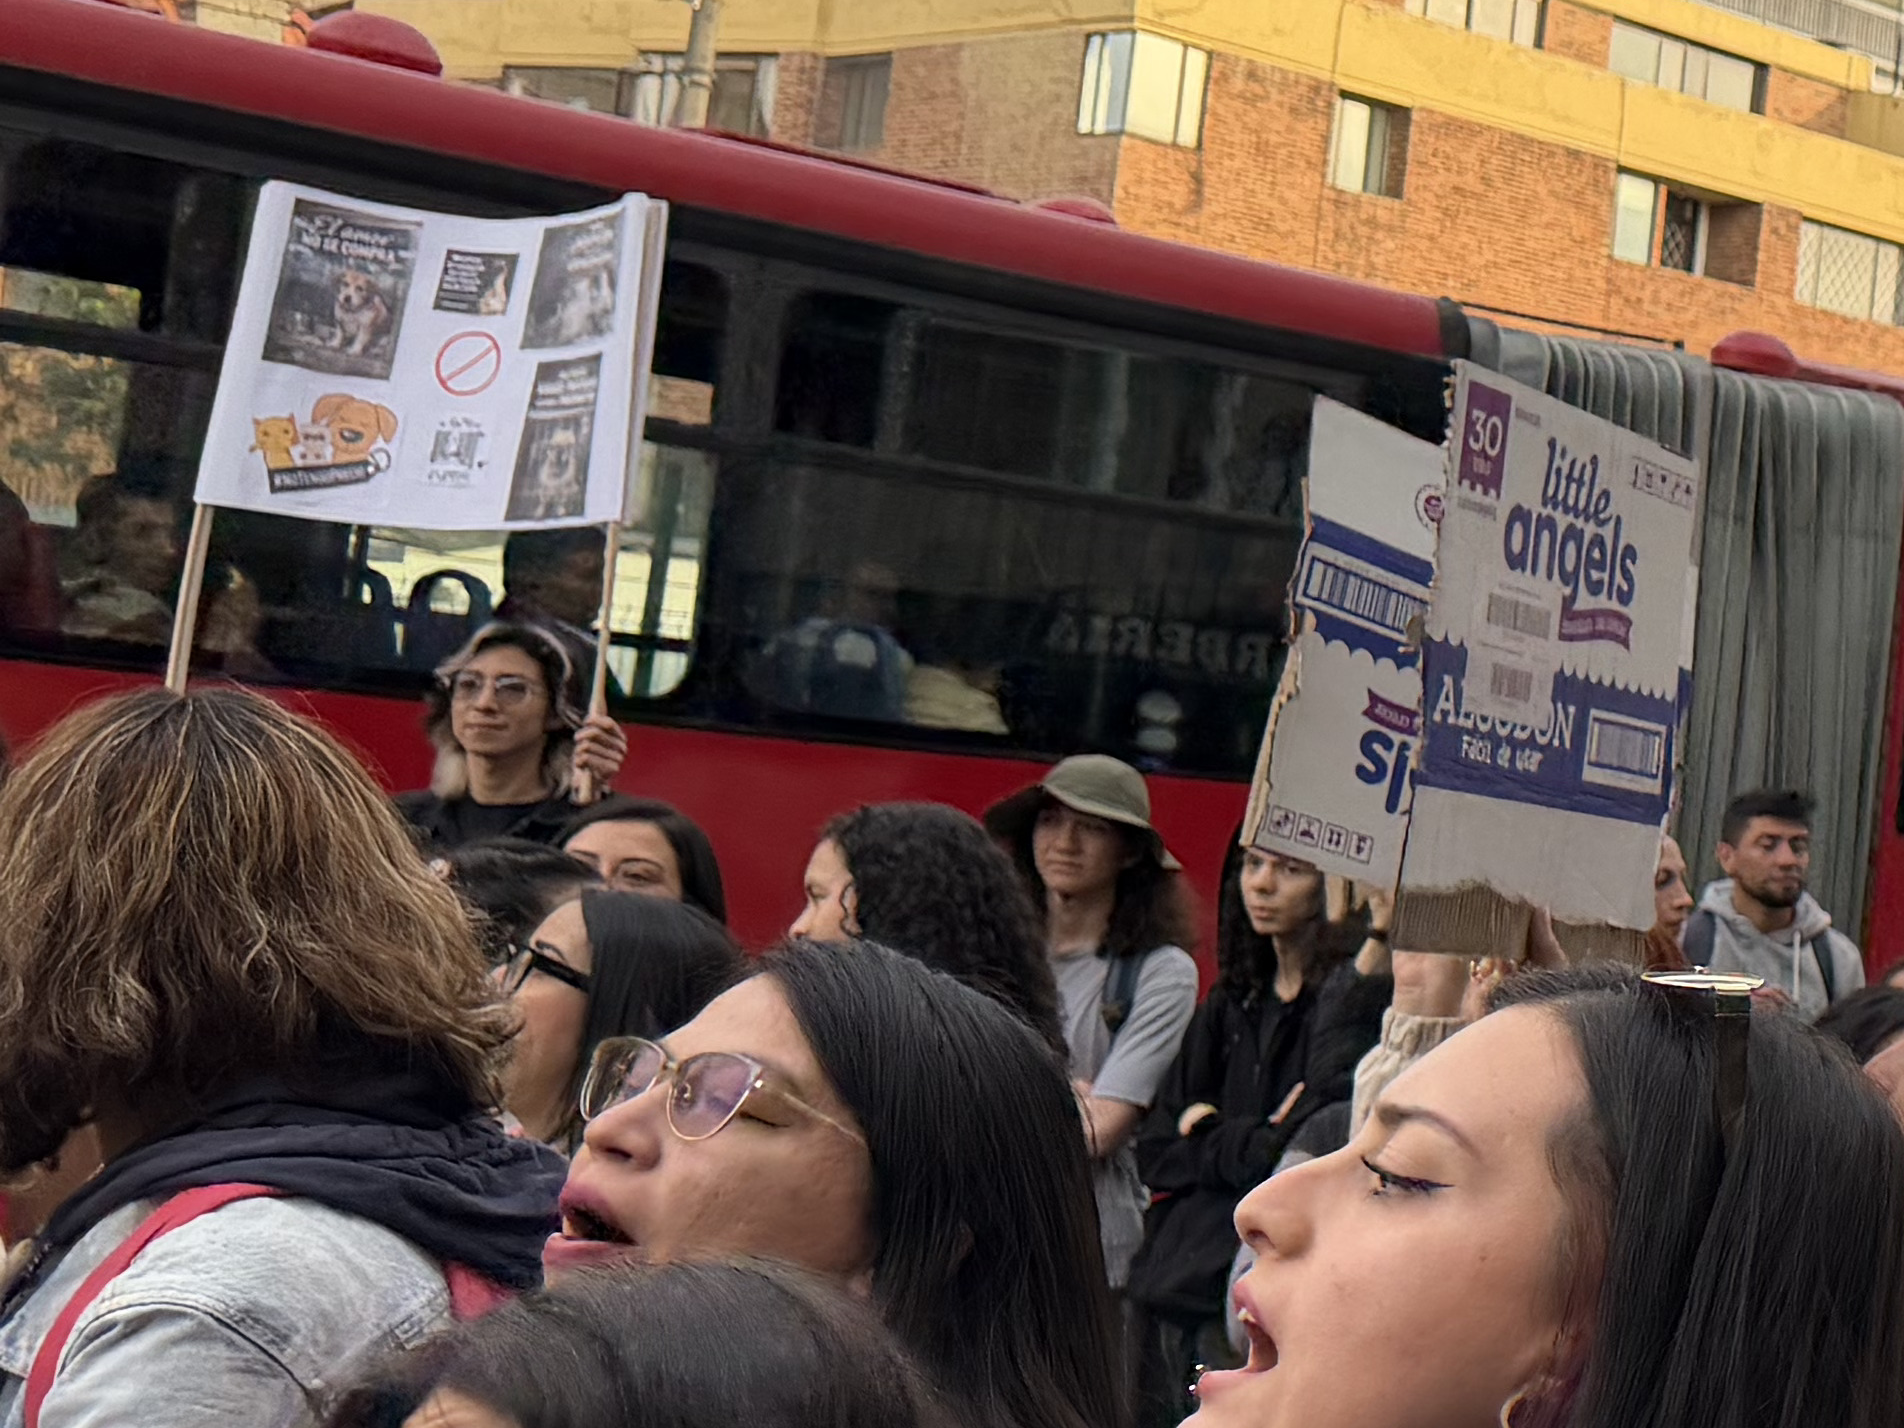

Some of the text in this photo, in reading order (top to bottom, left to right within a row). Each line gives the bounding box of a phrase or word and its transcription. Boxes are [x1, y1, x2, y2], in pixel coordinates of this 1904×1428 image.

[1468, 407, 1503, 458] 30
[1541, 436, 1613, 528] little
[1503, 502, 1638, 608] angels
